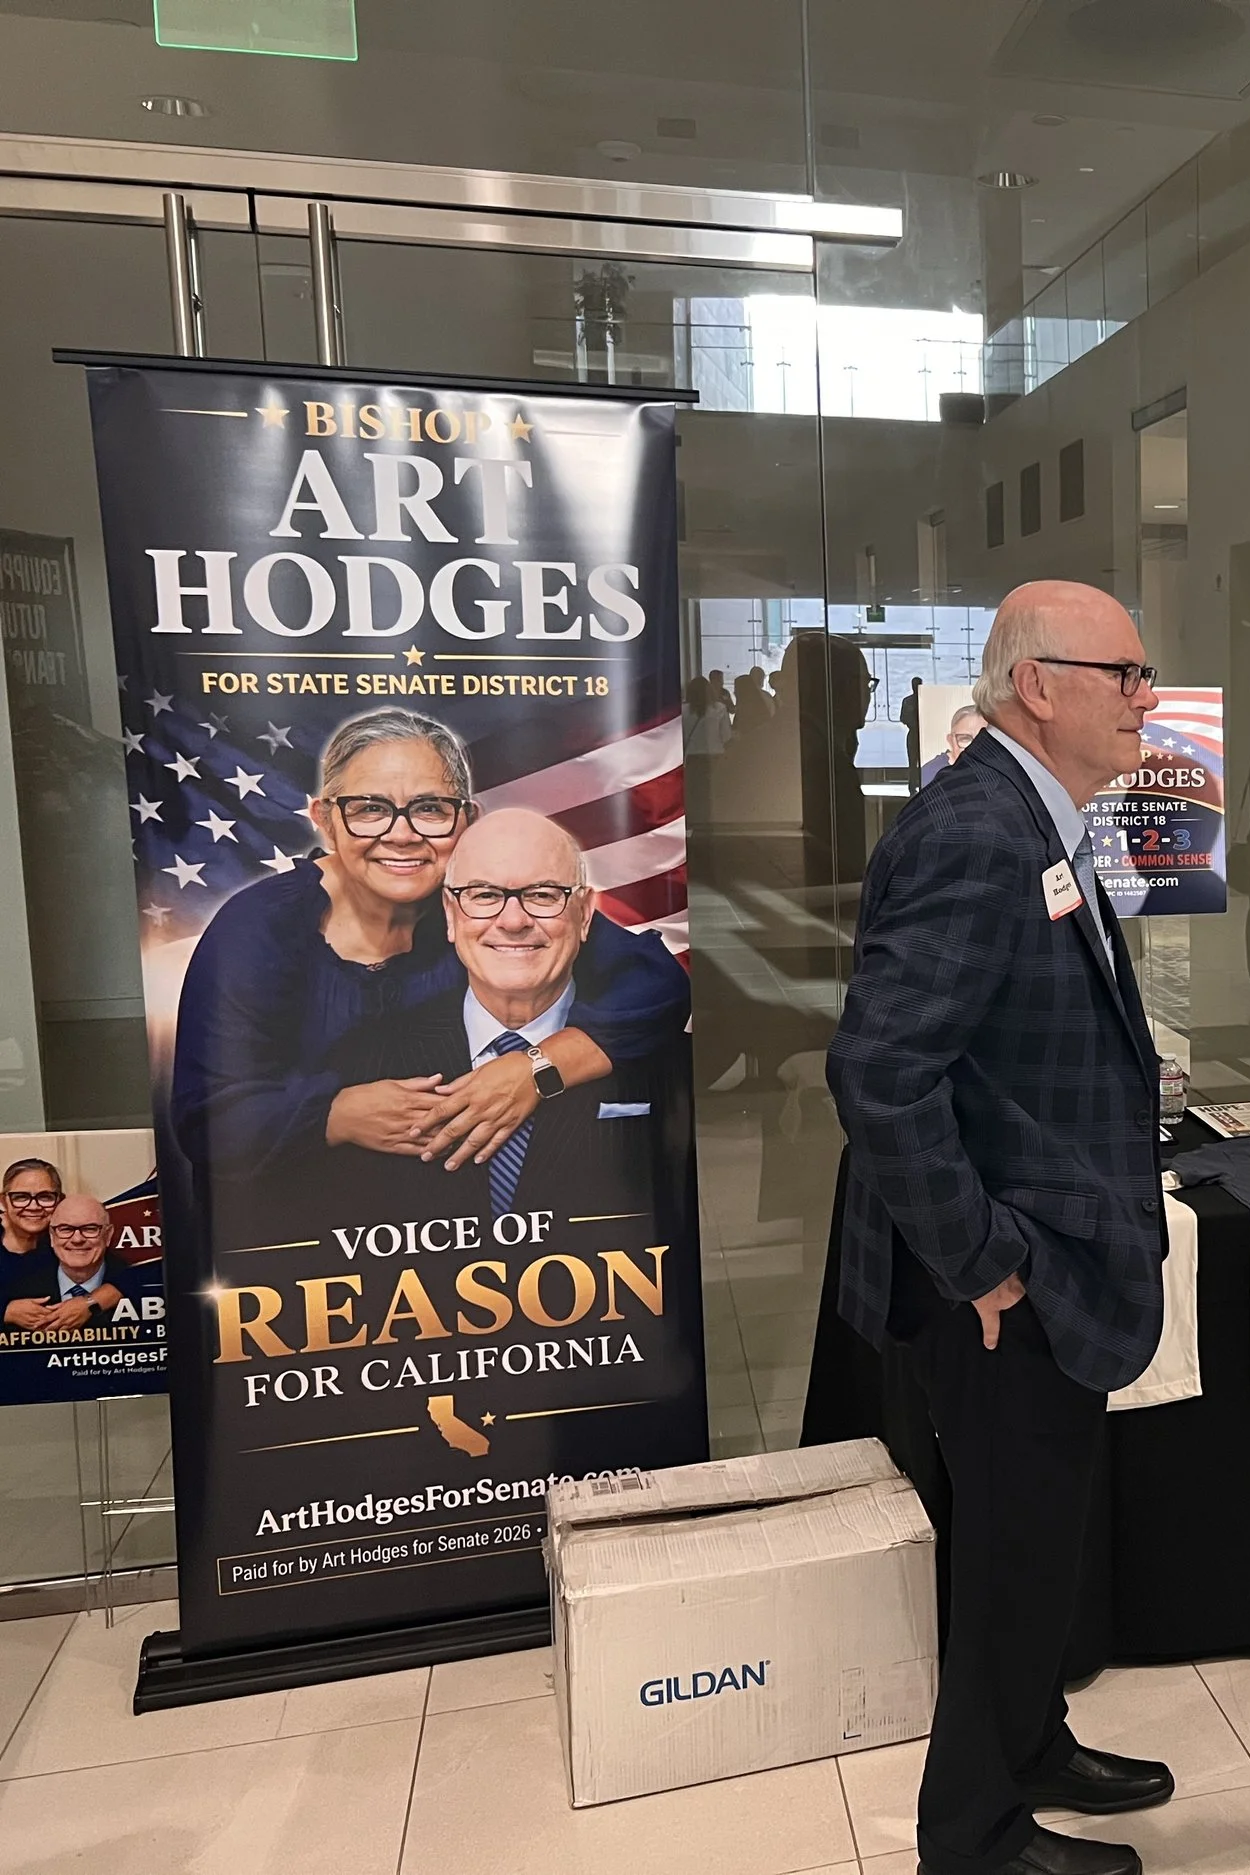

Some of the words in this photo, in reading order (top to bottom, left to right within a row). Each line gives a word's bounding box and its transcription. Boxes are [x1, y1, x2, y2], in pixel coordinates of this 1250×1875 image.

[302, 401, 490, 444] BISHOP
[269, 449, 533, 545] ART
[145, 549, 646, 641] HODGES
[202, 672, 258, 694] FOR
[267, 672, 349, 695] STATE
[356, 673, 456, 696] SENATE
[463, 674, 578, 696] DISTRICT
[584, 676, 609, 697] 18
[1093, 816, 1150, 826] DISTRICT
[1153, 815, 1166, 825] 18
[1102, 802, 1138, 812] STATE
[1142, 801, 1187, 811] SENATE
[1122, 854, 1174, 867] COMMON
[1177, 853, 1212, 865] SENSE
[332, 1216, 482, 1260] VOICE
[492, 1210, 554, 1246] OF
[212, 1245, 670, 1364] REASON
[0, 1325, 140, 1346] AFFORDABILITY
[72, 1369, 89, 1377] Paid
[103, 1368, 112, 1376] by
[244, 1365, 343, 1408] FOR
[360, 1333, 645, 1392] CALIFORNIA
[232, 1562, 267, 1582] Paid
[272, 1560, 294, 1577] for
[299, 1556, 318, 1574] by
[322, 1551, 346, 1568] Art
[351, 1545, 408, 1564] Hodges
[413, 1539, 434, 1555] for
[438, 1532, 490, 1552] Senate
[493, 1524, 531, 1544] 2026
[640, 1661, 765, 1706] GILDAN
